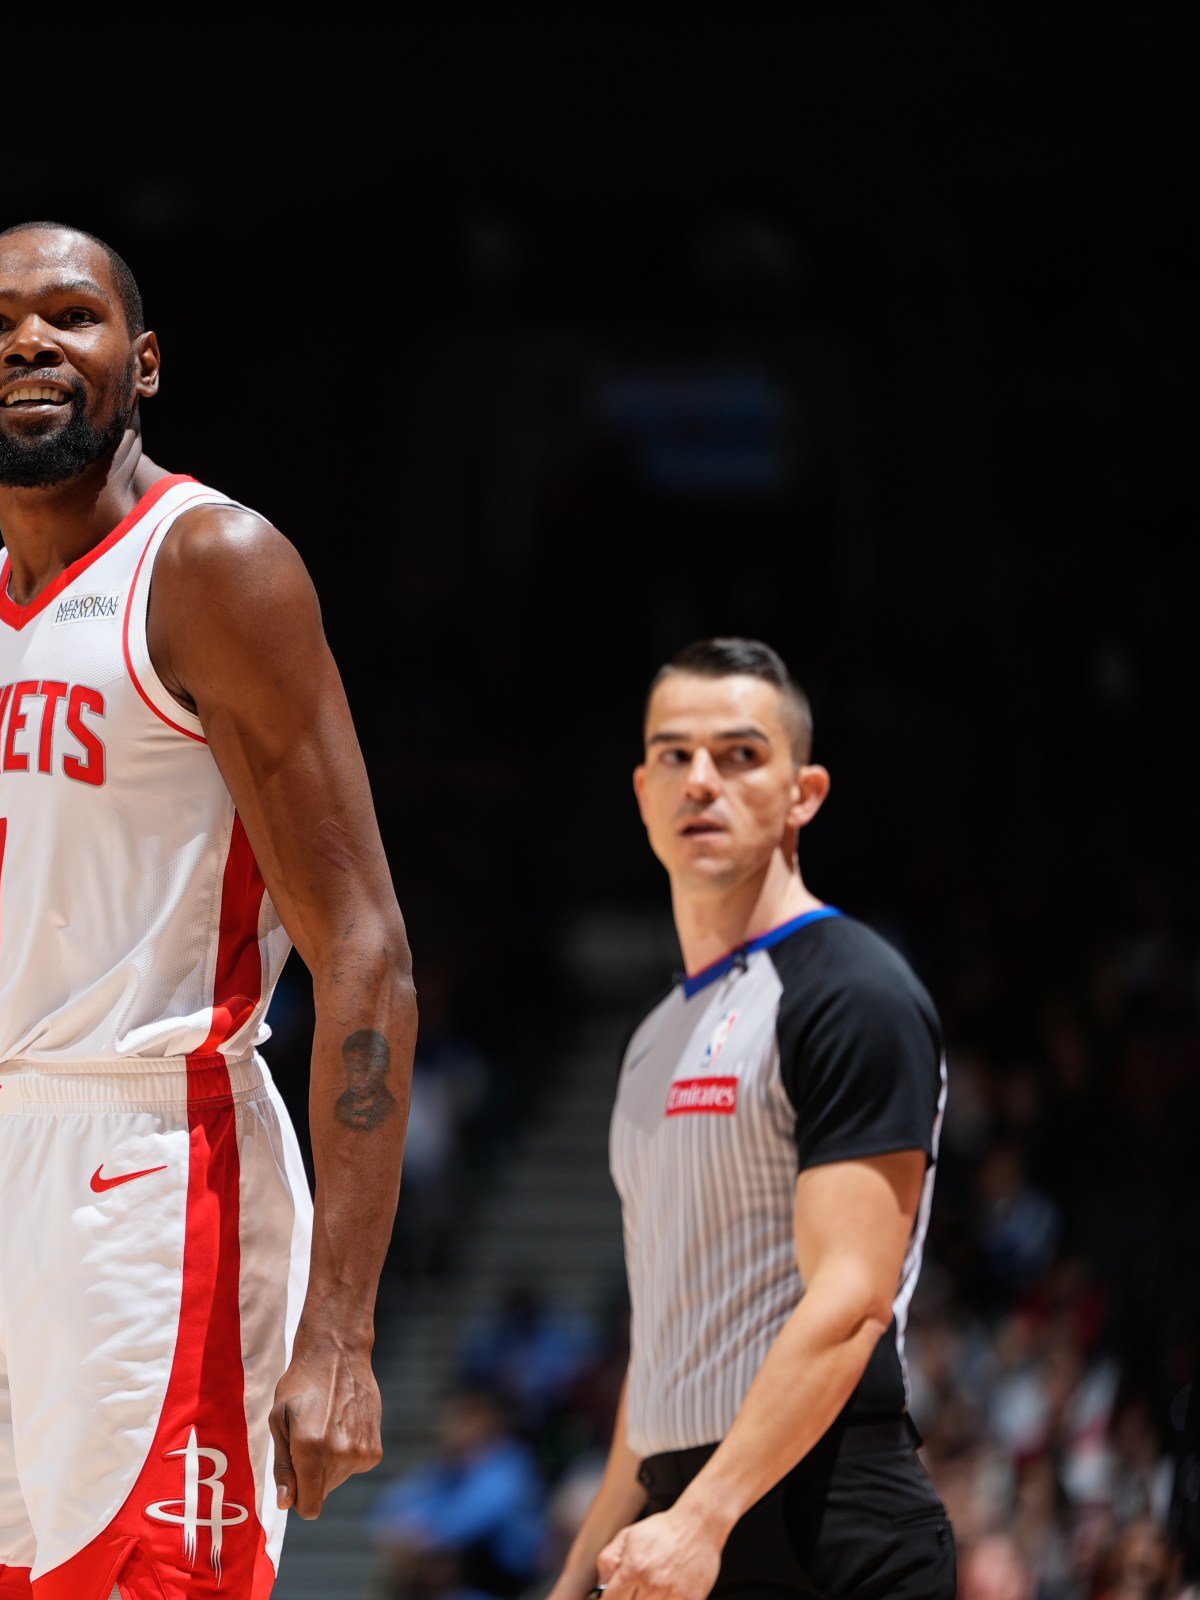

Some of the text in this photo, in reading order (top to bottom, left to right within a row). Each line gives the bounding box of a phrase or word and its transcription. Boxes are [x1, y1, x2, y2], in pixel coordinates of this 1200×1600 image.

[55, 605, 118, 623] HERMANN
[58, 596, 119, 614] MEMORIAL
[668, 1083, 735, 1110] Emirates
